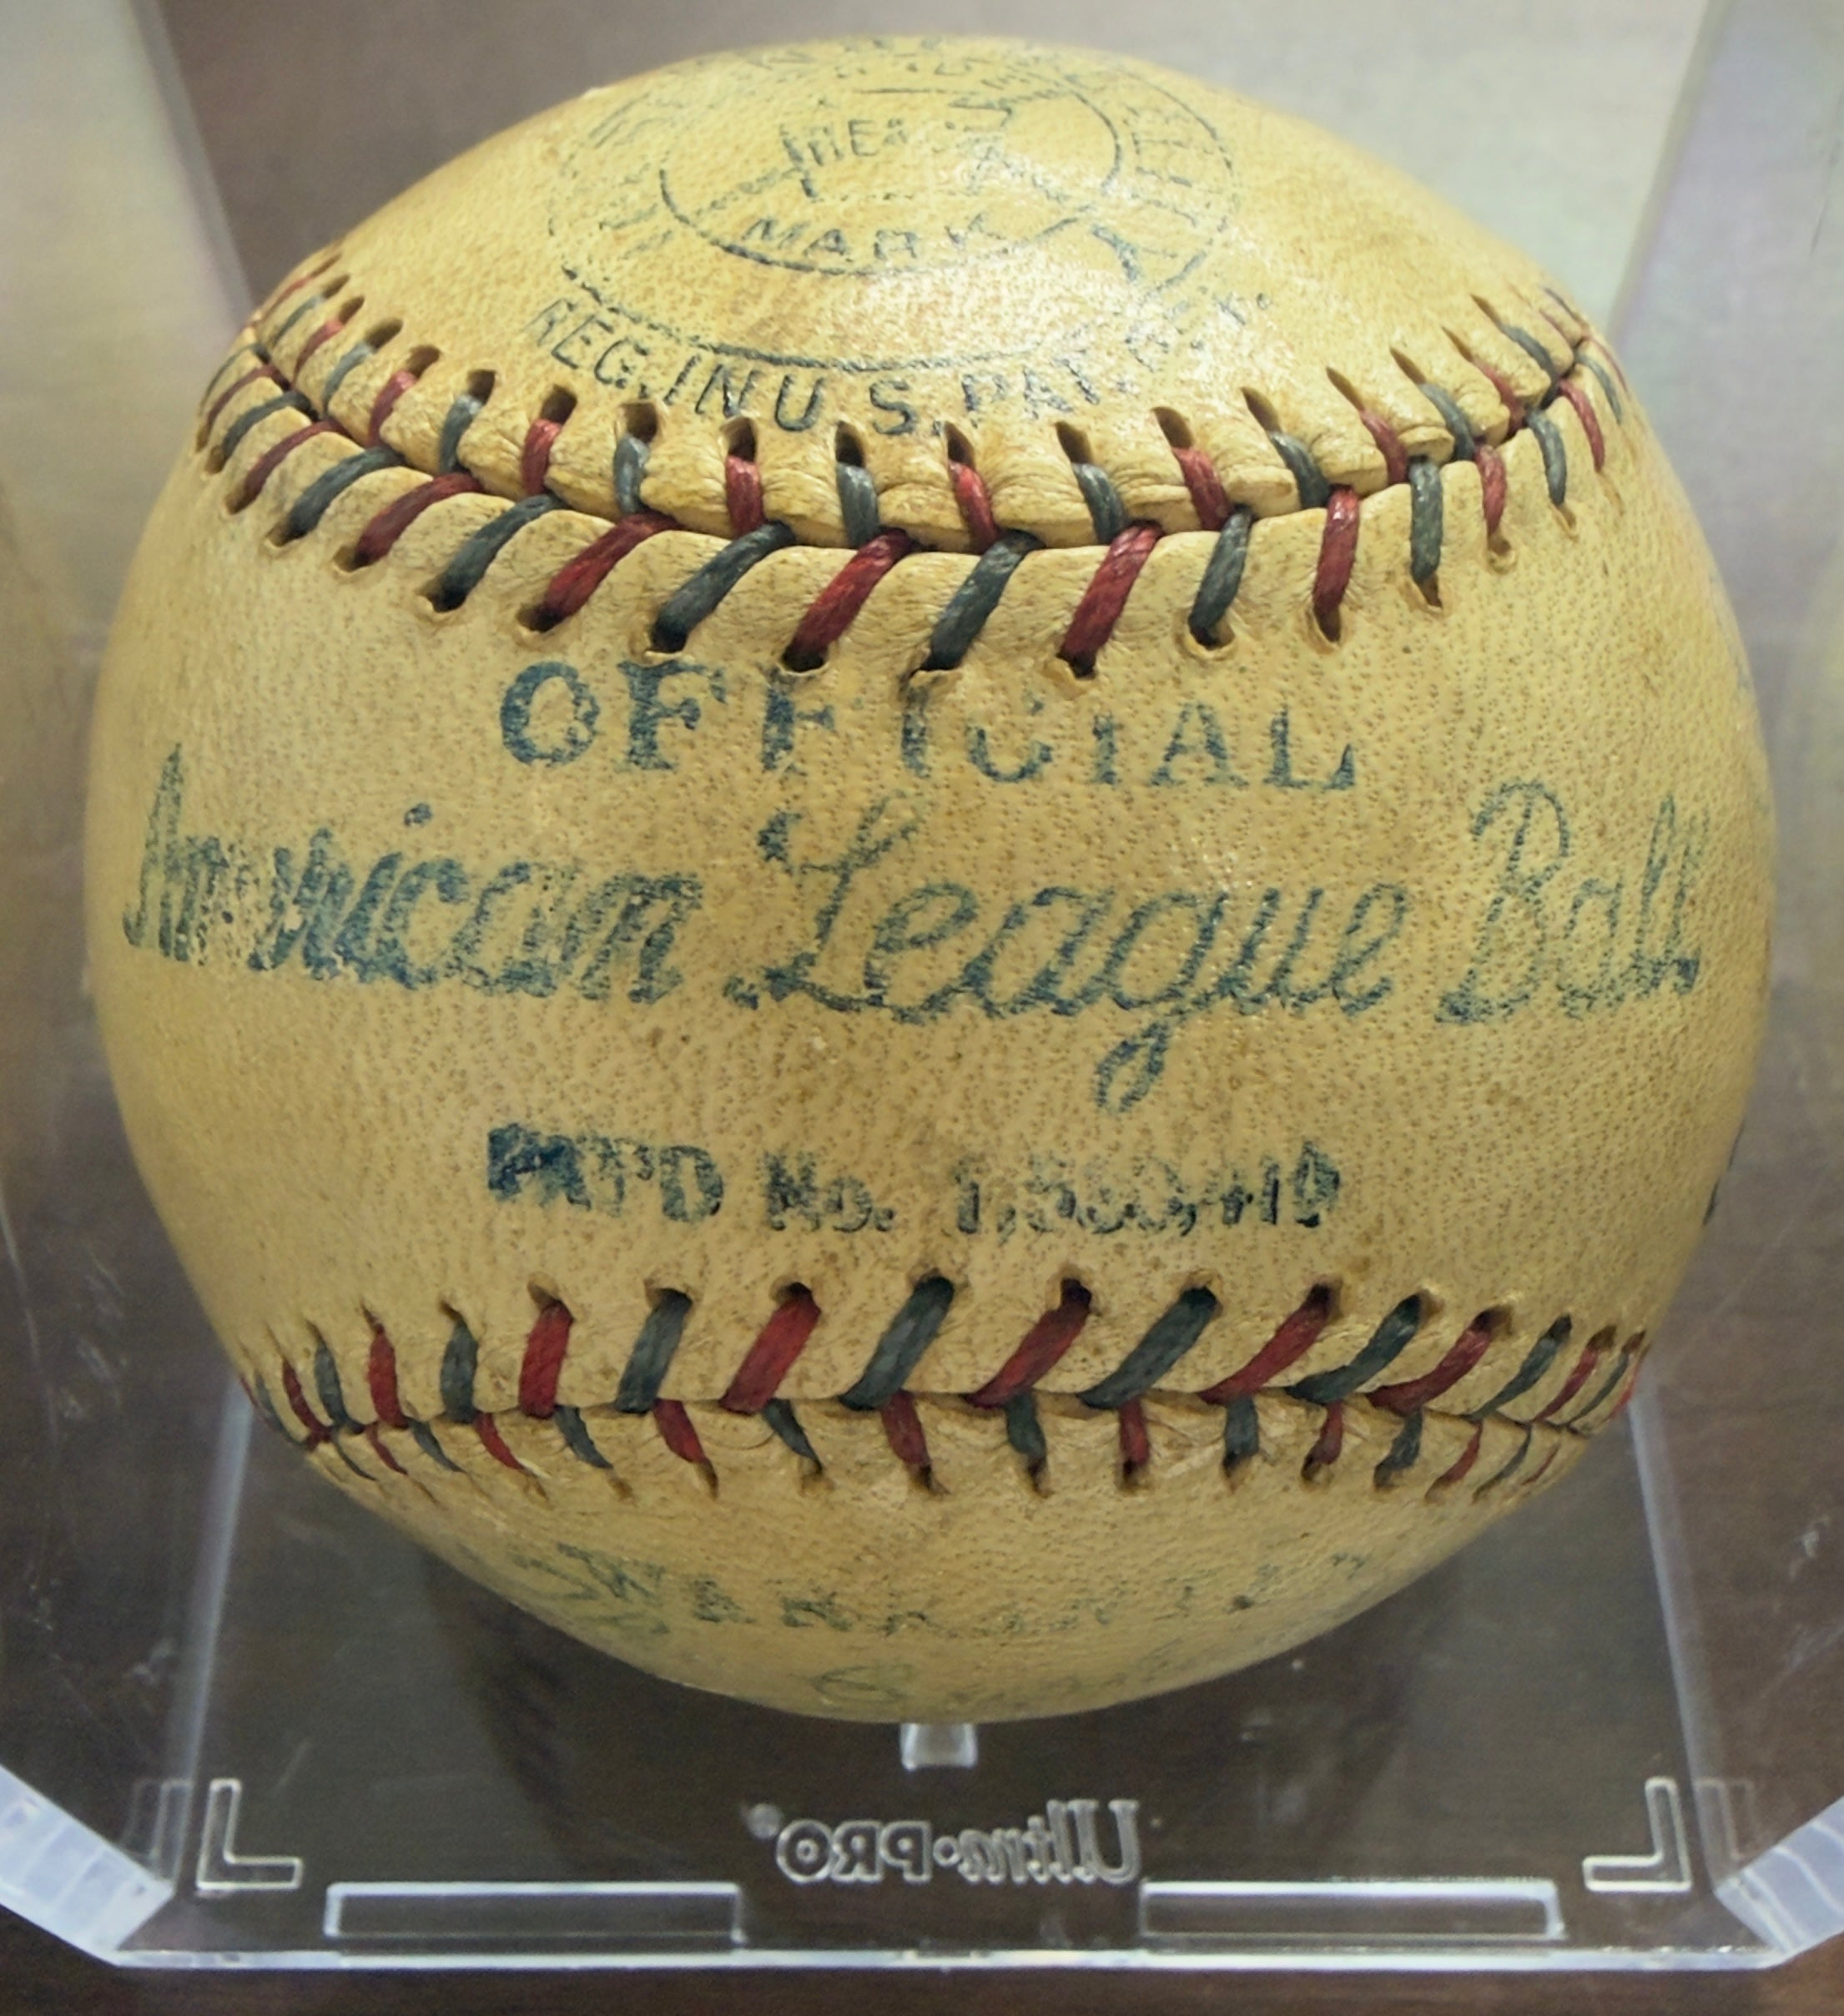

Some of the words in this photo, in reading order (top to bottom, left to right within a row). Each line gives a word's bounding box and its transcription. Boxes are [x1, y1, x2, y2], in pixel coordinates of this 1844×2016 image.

[664, 354, 762, 417] IN
[499, 659, 1355, 791] OFFICIAL
[724, 789, 1410, 1115] League
